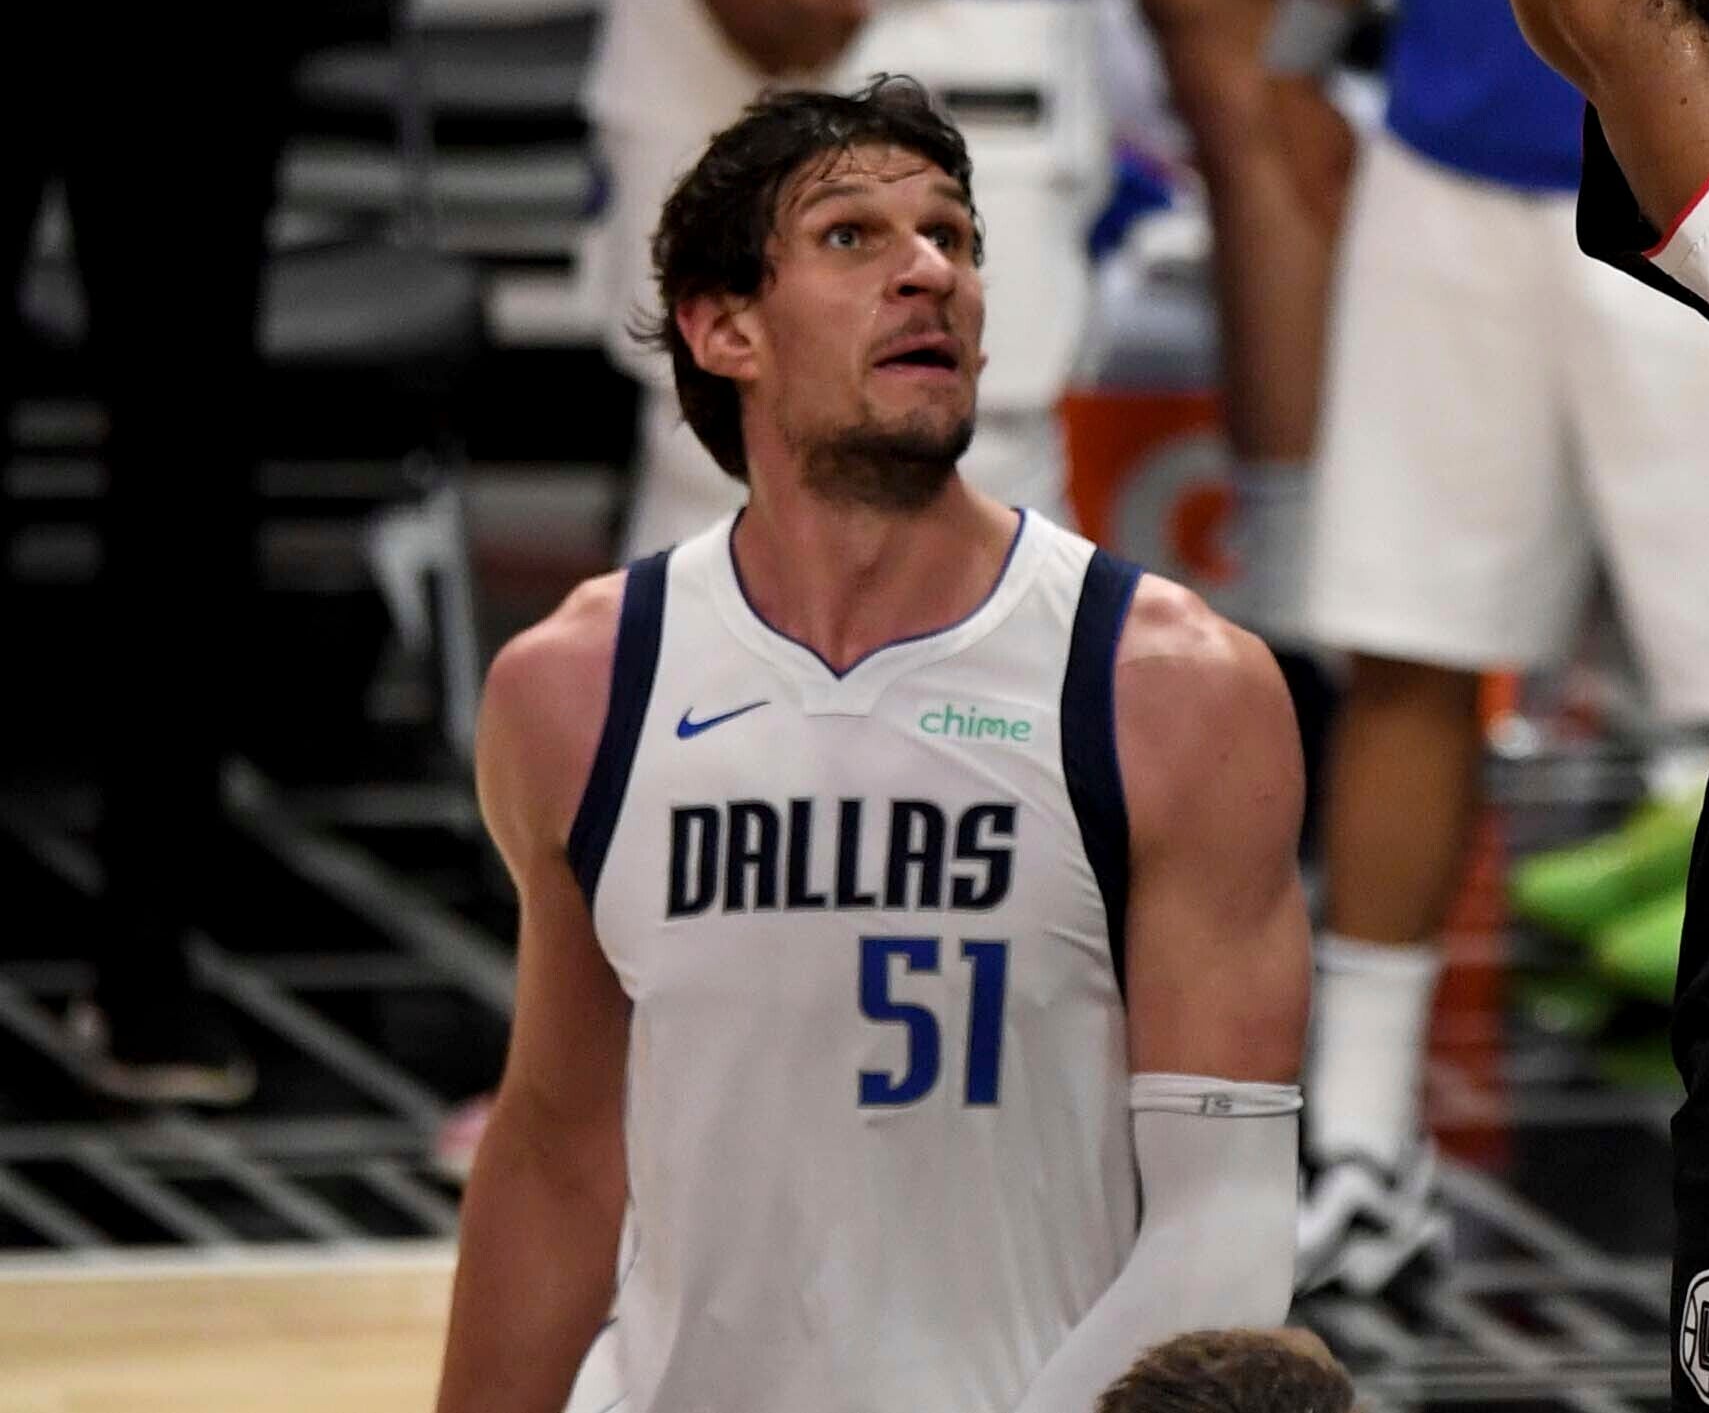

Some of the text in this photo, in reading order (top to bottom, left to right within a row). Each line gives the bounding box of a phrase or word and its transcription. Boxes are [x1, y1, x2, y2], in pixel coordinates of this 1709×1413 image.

[919, 702, 1033, 743] chime
[664, 796, 1022, 923] DALLAS
[856, 934, 1012, 1110] 51
